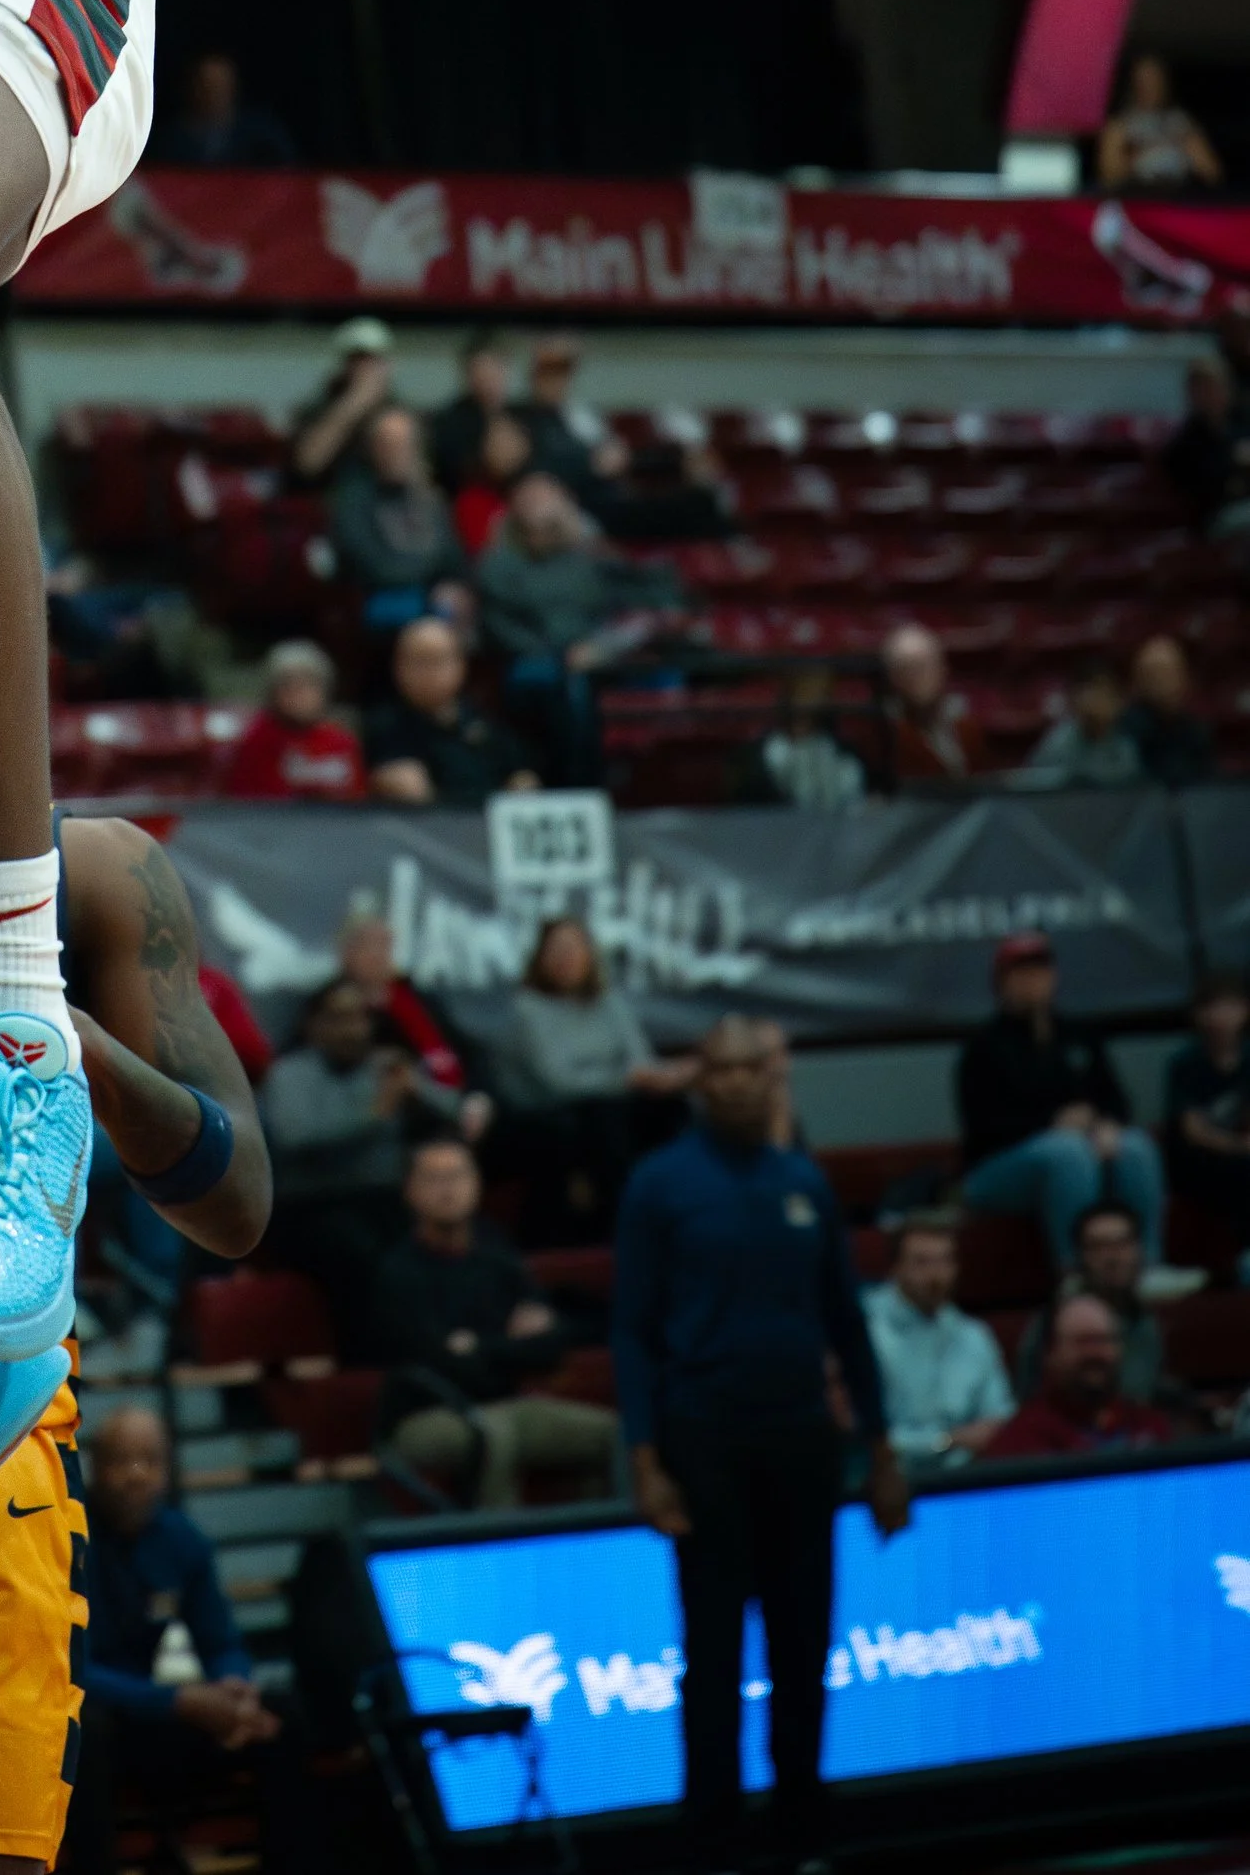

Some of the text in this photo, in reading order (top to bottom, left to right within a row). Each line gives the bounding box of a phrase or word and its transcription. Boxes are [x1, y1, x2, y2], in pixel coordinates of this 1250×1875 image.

[466, 216, 637, 299] Main
[794, 227, 1012, 307] Health
[849, 1608, 1043, 1684] Health
